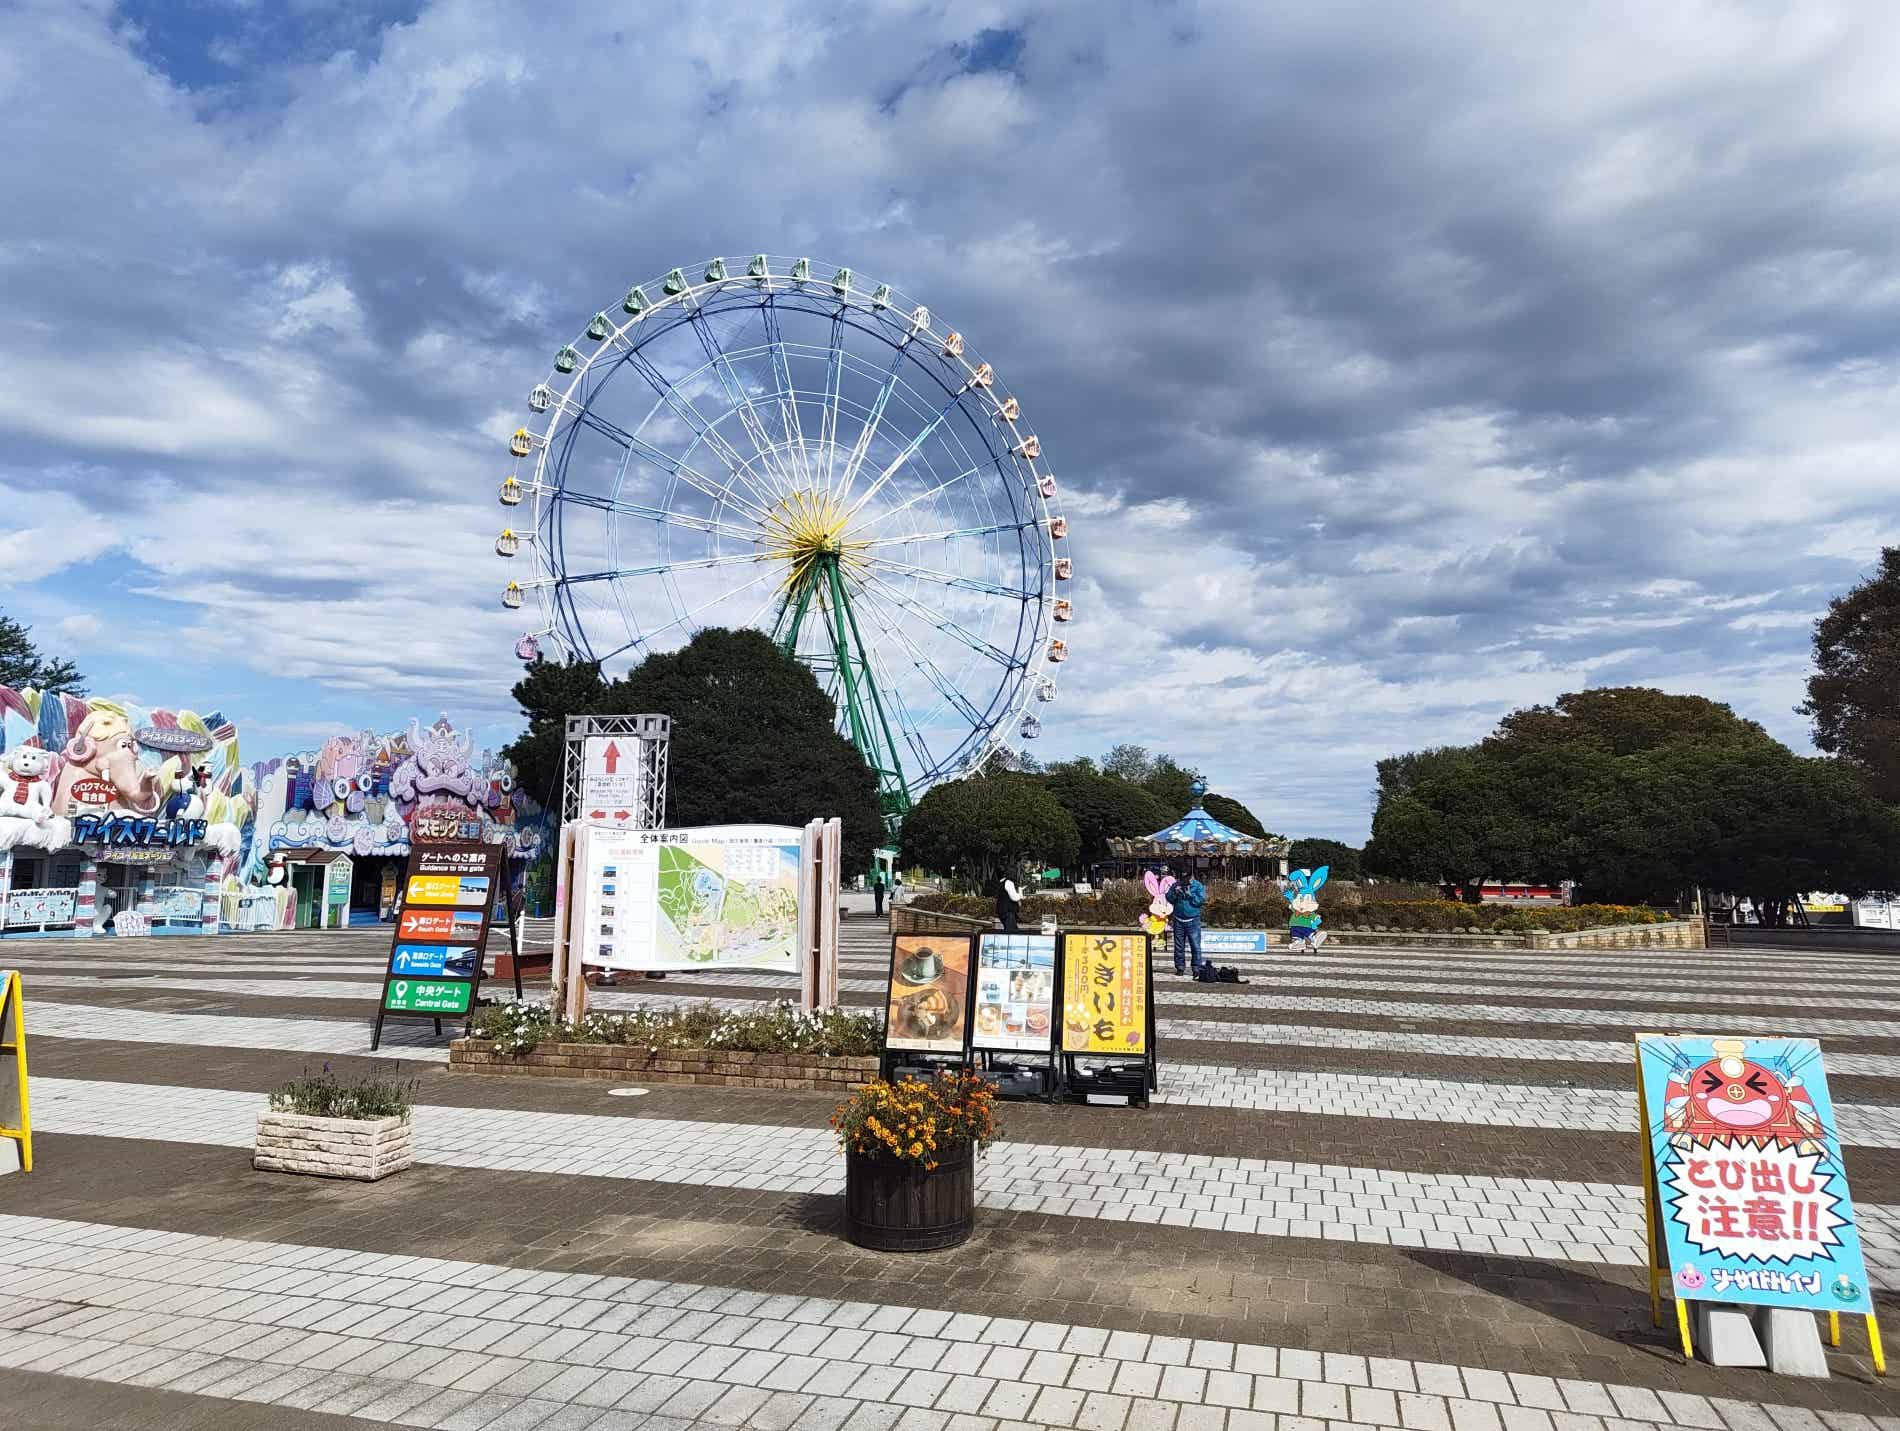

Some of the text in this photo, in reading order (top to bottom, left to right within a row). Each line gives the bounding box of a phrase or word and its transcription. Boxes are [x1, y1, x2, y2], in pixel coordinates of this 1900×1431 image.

[72, 782, 117, 795] シロクマくんと
[75, 812, 208, 847] アイスワールド
[640, 832, 689, 844] 全体案内図
[421, 852, 487, 864] ゲートへのご案内
[419, 864, 449, 872] Guidance
[415, 985, 462, 997] 中央ゲート
[1093, 936, 1117, 1041] やきいも
[415, 998, 460, 1009] Central Gate
[1687, 1158, 1816, 1195] とび出し
[1697, 1195, 1819, 1242] 注意!!
[1711, 1268, 1823, 1296] シーサイドトレイン
